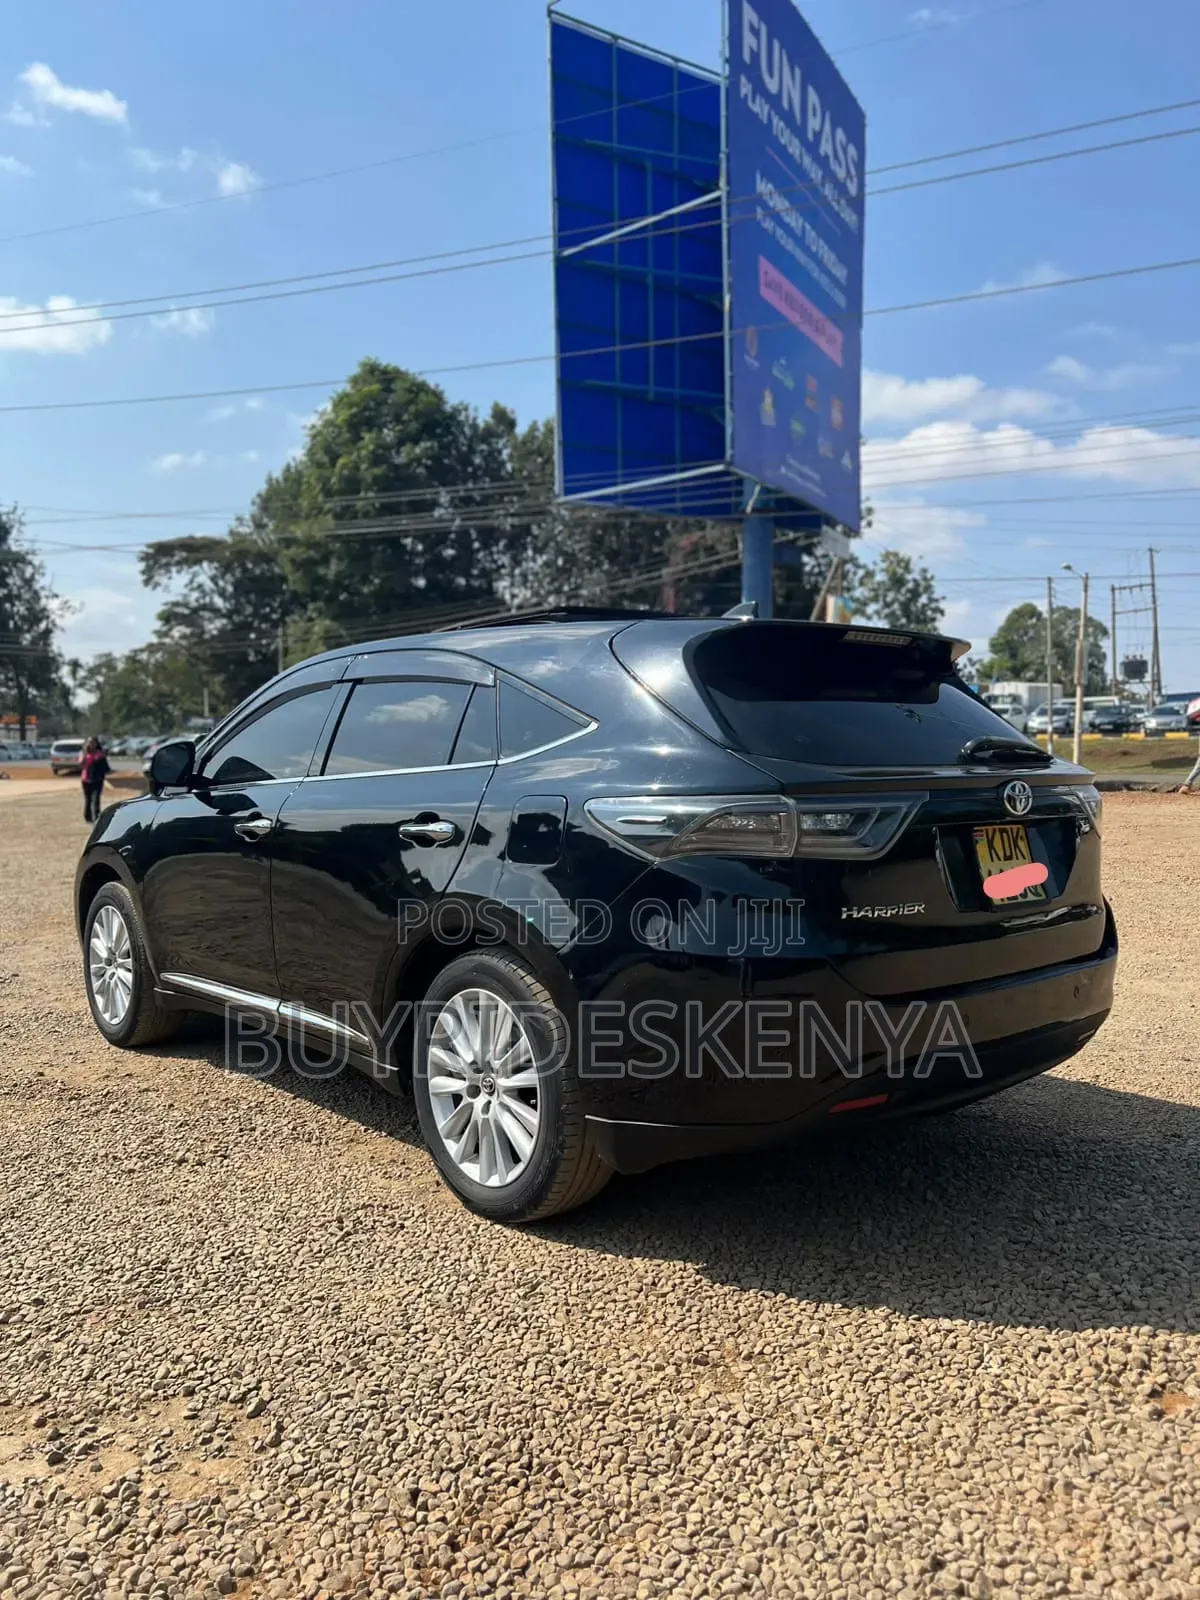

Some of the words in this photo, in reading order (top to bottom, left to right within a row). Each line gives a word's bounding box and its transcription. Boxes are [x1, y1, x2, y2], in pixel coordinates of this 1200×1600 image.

[740, 73, 770, 124] PLAY
[770, 109, 802, 163] YOUR
[742, 0, 802, 128] FUN
[807, 83, 859, 198] PASS
[756, 168, 804, 237] MONDAY
[803, 221, 818, 253] TO
[985, 826, 1026, 862] KDK
[841, 902, 926, 920] HARRIER
